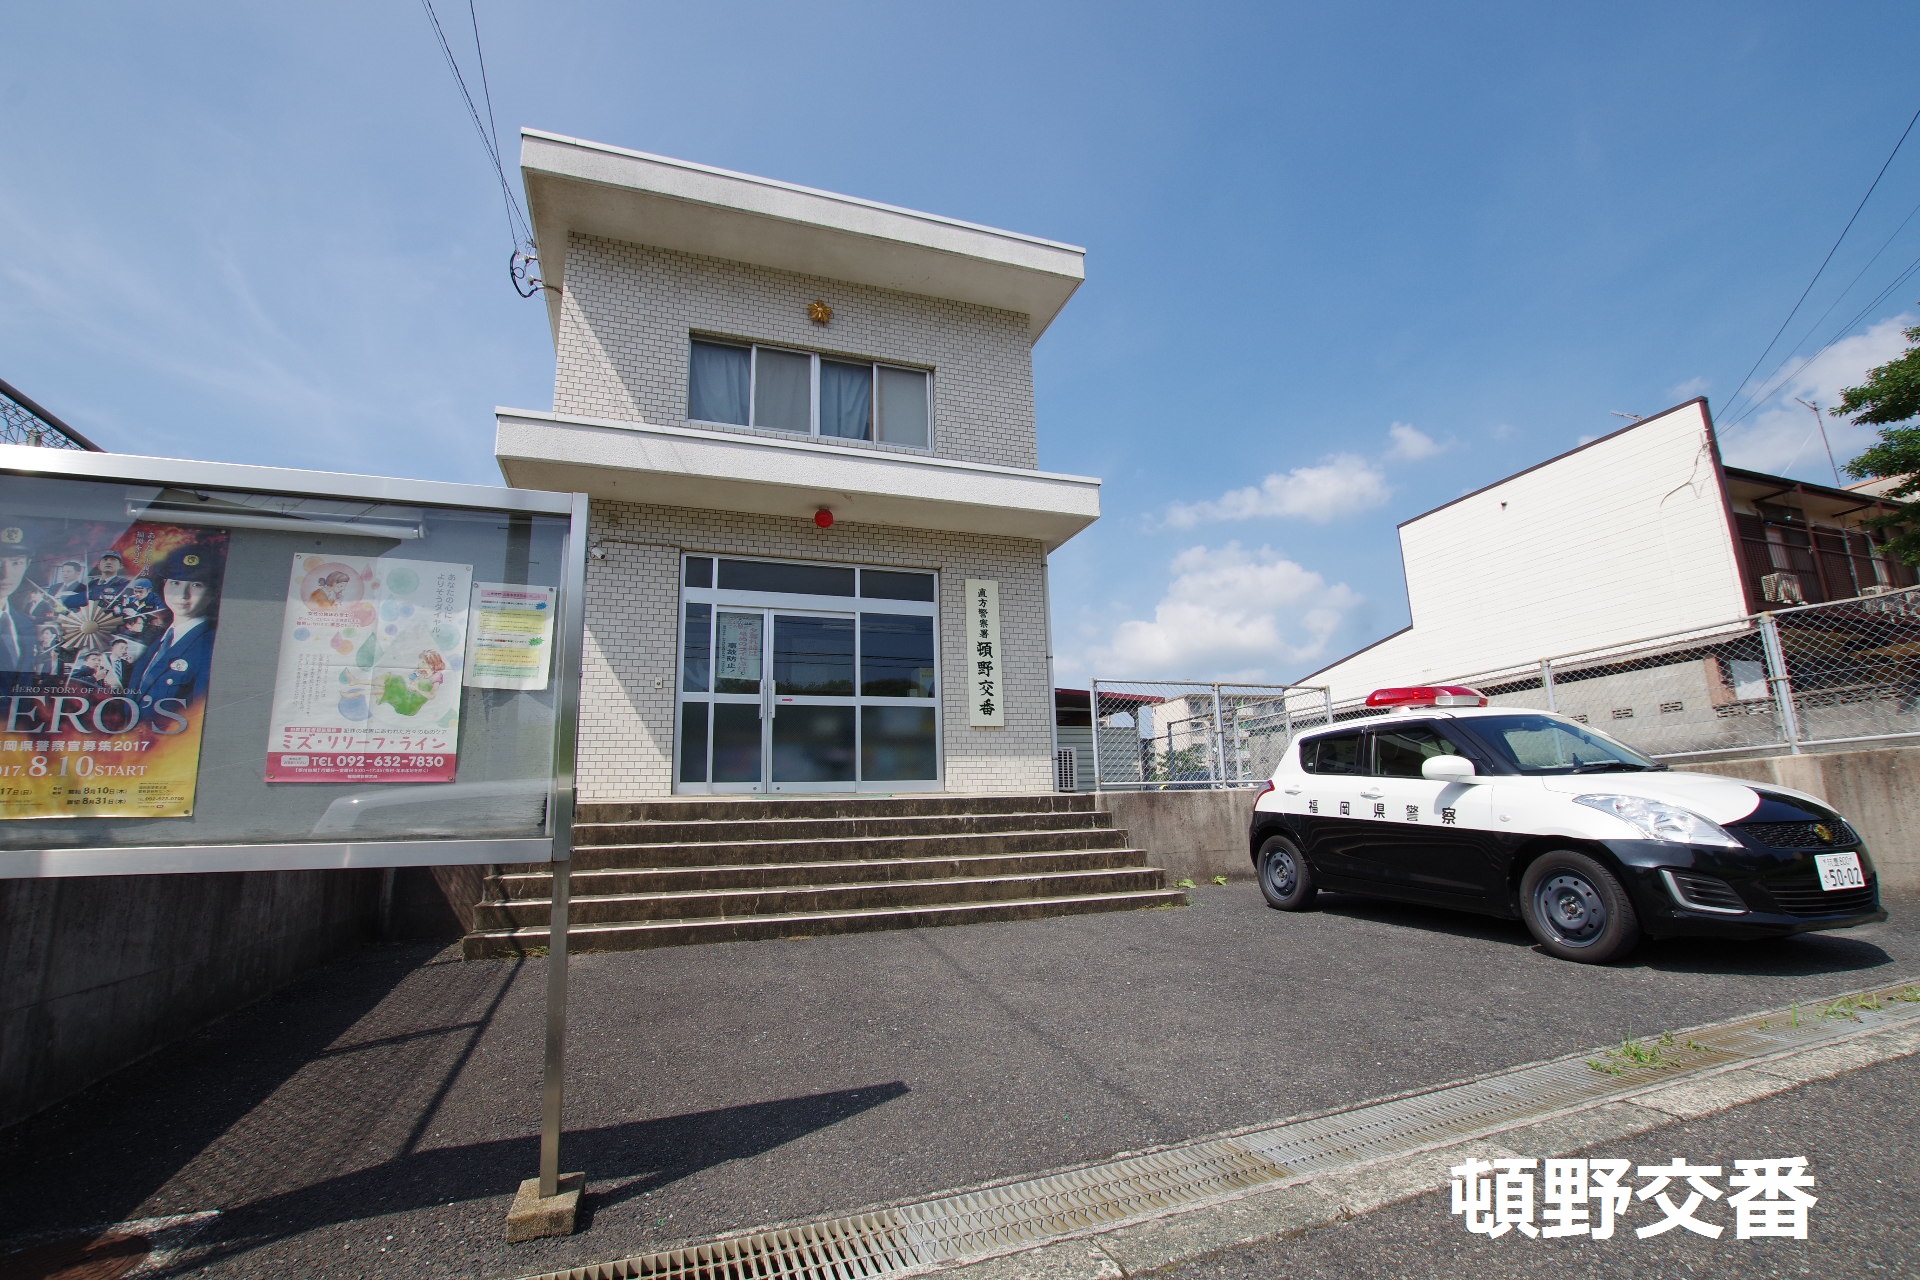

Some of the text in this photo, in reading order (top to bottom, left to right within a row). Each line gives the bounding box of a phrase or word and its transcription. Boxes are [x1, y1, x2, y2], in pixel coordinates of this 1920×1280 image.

[976, 588, 996, 716] 直方警察署 頓野交番
[12, 685, 142, 695] HERO STORY OF FUKUOKA
[0, 695, 188, 735] ERO'S
[0, 740, 151, 752] 岡県警察官募集2017
[283, 733, 447, 750] ミズ・リリーフ・ライン
[311, 756, 334, 767] TEL
[336, 755, 445, 767] 092-632-7830
[1308, 799, 1456, 825] 福岡県警察
